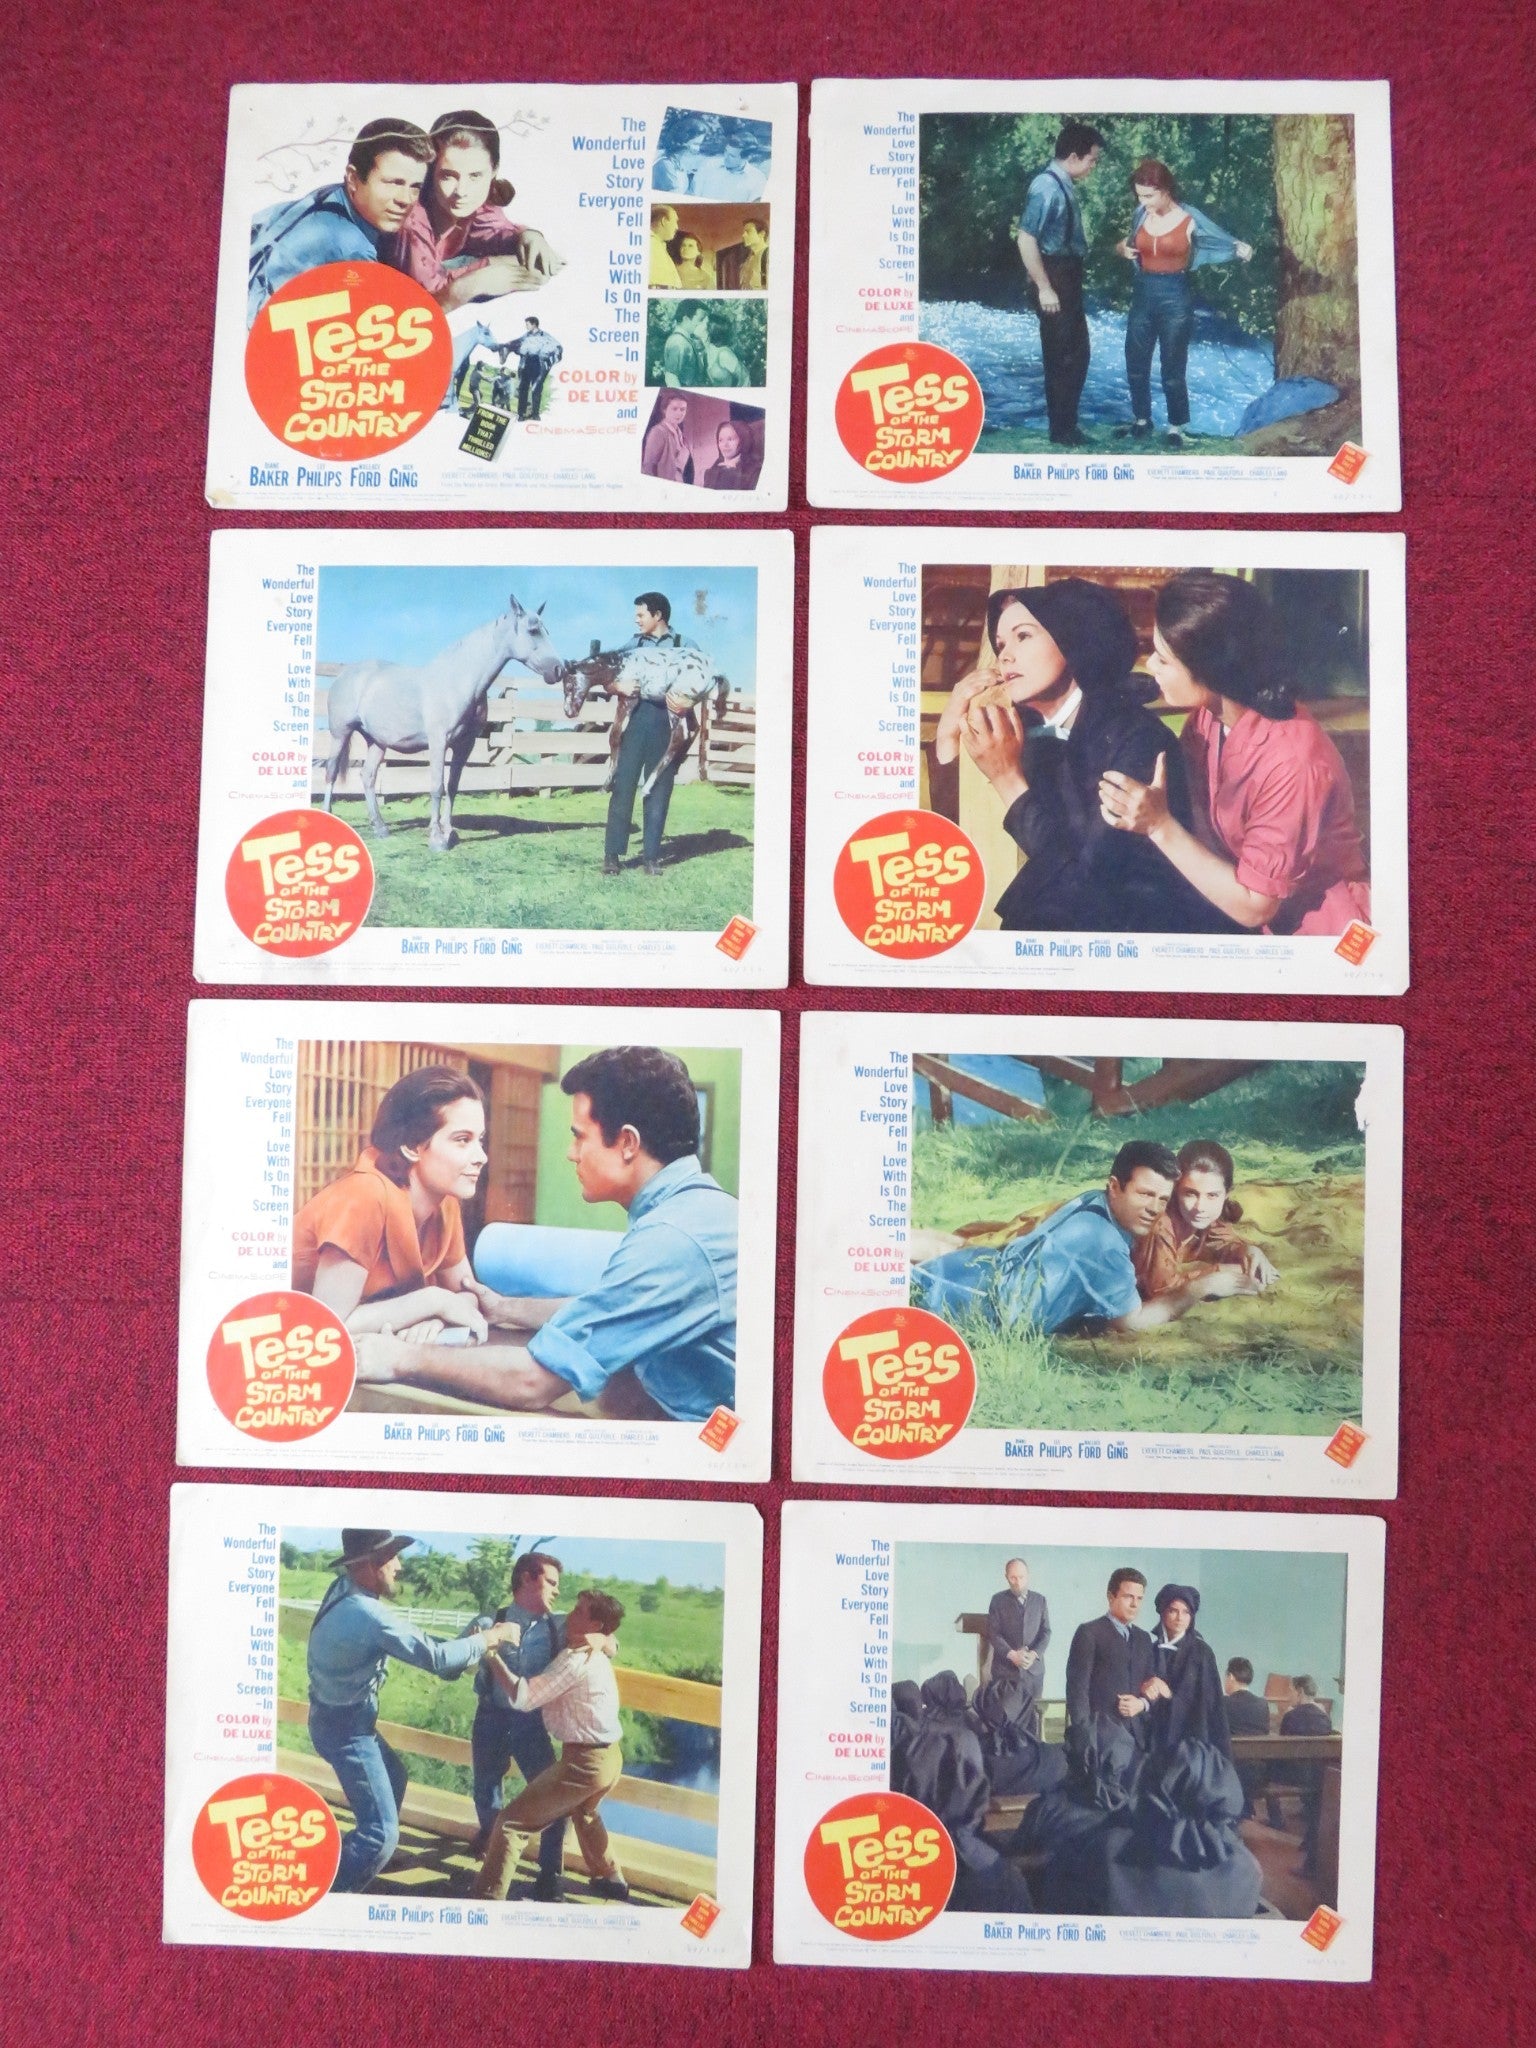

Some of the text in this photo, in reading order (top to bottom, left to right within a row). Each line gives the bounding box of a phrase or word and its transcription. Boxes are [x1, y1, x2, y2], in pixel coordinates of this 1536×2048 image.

[621, 117, 646, 132] The
[864, 124, 915, 136] Wonderful
[572, 136, 646, 150] Wonderful
[612, 155, 645, 170] Love
[888, 151, 915, 163] Story
[870, 164, 915, 177] Everyone
[606, 174, 644, 192] Story
[579, 192, 643, 210] Everyone
[618, 212, 643, 227] Fell
[629, 231, 642, 246] In
[610, 250, 642, 265] Love
[879, 258, 914, 269] Screen
[610, 269, 641, 284] With
[605, 288, 640, 304] Is On
[865, 301, 914, 311] DE LUXE
[615, 308, 640, 323] The
[589, 327, 639, 342] Screen
[321, 359, 391, 378] OF THE
[559, 371, 636, 386] COLOR by
[300, 379, 404, 411] STORM
[568, 389, 638, 404] DE LUXE
[617, 406, 638, 418] and
[890, 411, 940, 426] OF THE
[285, 411, 422, 441] COUNTRY
[876, 427, 950, 449] STORM
[865, 448, 963, 470] COUNTRY
[250, 466, 418, 488] BAKER PHILIPS FORD GING
[1014, 464, 1041, 479] BAKER
[1048, 464, 1080, 480] PHILIPS
[1086, 464, 1108, 480] FORD
[1114, 464, 1134, 480] GING
[262, 578, 314, 590] Wonderful
[863, 576, 916, 588] Wonderful
[286, 606, 312, 620] Story
[888, 605, 916, 618] Story
[267, 620, 312, 634] Everyone
[870, 619, 916, 632] Everyone
[274, 720, 309, 732] Screen
[879, 720, 915, 732] Screen
[258, 766, 307, 776] DE LUXE
[864, 766, 914, 776] DE LUXE
[280, 883, 329, 897] OF THE
[890, 884, 939, 898] OF THE
[265, 898, 340, 921] STORM
[875, 899, 951, 923] STORM
[254, 921, 352, 943] COUNTRY
[865, 923, 963, 945] COUNTRY
[402, 938, 430, 954] BAKER
[436, 938, 467, 954] PHILIPS
[474, 939, 496, 954] FORD
[502, 939, 522, 954] GING
[1016, 940, 1044, 956] BAKER
[1050, 942, 1082, 957] PHILIPS
[1089, 942, 1111, 957] FORD
[1117, 942, 1138, 958] GING
[240, 1052, 293, 1064] Wonderful
[854, 1066, 908, 1078] Wonderful
[265, 1082, 292, 1096] Story
[246, 1096, 291, 1110] Everyone
[880, 1096, 908, 1110] Story
[860, 1110, 907, 1125] Everyone
[253, 1200, 288, 1212] Screen
[869, 1214, 906, 1226] Screen
[238, 1246, 287, 1256] DE LUXE
[854, 1262, 905, 1272] DE LUXE
[261, 1365, 310, 1380] OF THE
[246, 1381, 321, 1405] STORM
[879, 1382, 929, 1397] OF THE
[235, 1405, 333, 1428] COUNTRY
[864, 1398, 940, 1422] STORM
[384, 1424, 412, 1440] BAKER
[418, 1426, 450, 1441] PHILIPS
[456, 1426, 478, 1442] FORD
[484, 1427, 505, 1442] GING
[853, 1422, 953, 1445] COUNTRY
[1005, 1442, 1033, 1457] BAKER
[1040, 1442, 1072, 1458] PHILIPS
[1079, 1443, 1101, 1458] FORD
[1107, 1444, 1128, 1459] GING
[224, 1537, 276, 1550] Wonderful
[836, 1554, 889, 1566] Wonderful
[248, 1567, 275, 1582] Story
[228, 1580, 275, 1595] Everyone
[861, 1584, 888, 1598] Story
[842, 1598, 888, 1612] Everyone
[237, 1682, 273, 1696] Screen
[850, 1701, 886, 1713] Screen
[223, 1728, 274, 1740] DE LUXE
[835, 1748, 885, 1758] DE LUXE
[247, 1846, 296, 1860] OF THE
[233, 1861, 306, 1884] STORM
[860, 1865, 909, 1880] OF THE
[222, 1884, 319, 1907] COUNTRY
[845, 1881, 920, 1904] STORM
[368, 1905, 396, 1920] BAKER
[402, 1907, 433, 1922] PHILIPS
[440, 1908, 462, 1924] FORD
[468, 1910, 488, 1925] GING
[834, 1904, 933, 1927] COUNTRY
[984, 1923, 1012, 1939] BAKER
[1018, 1925, 1050, 1940] PHILIPS
[1057, 1925, 1079, 1941] FORD
[1085, 1926, 1106, 1941] GING
